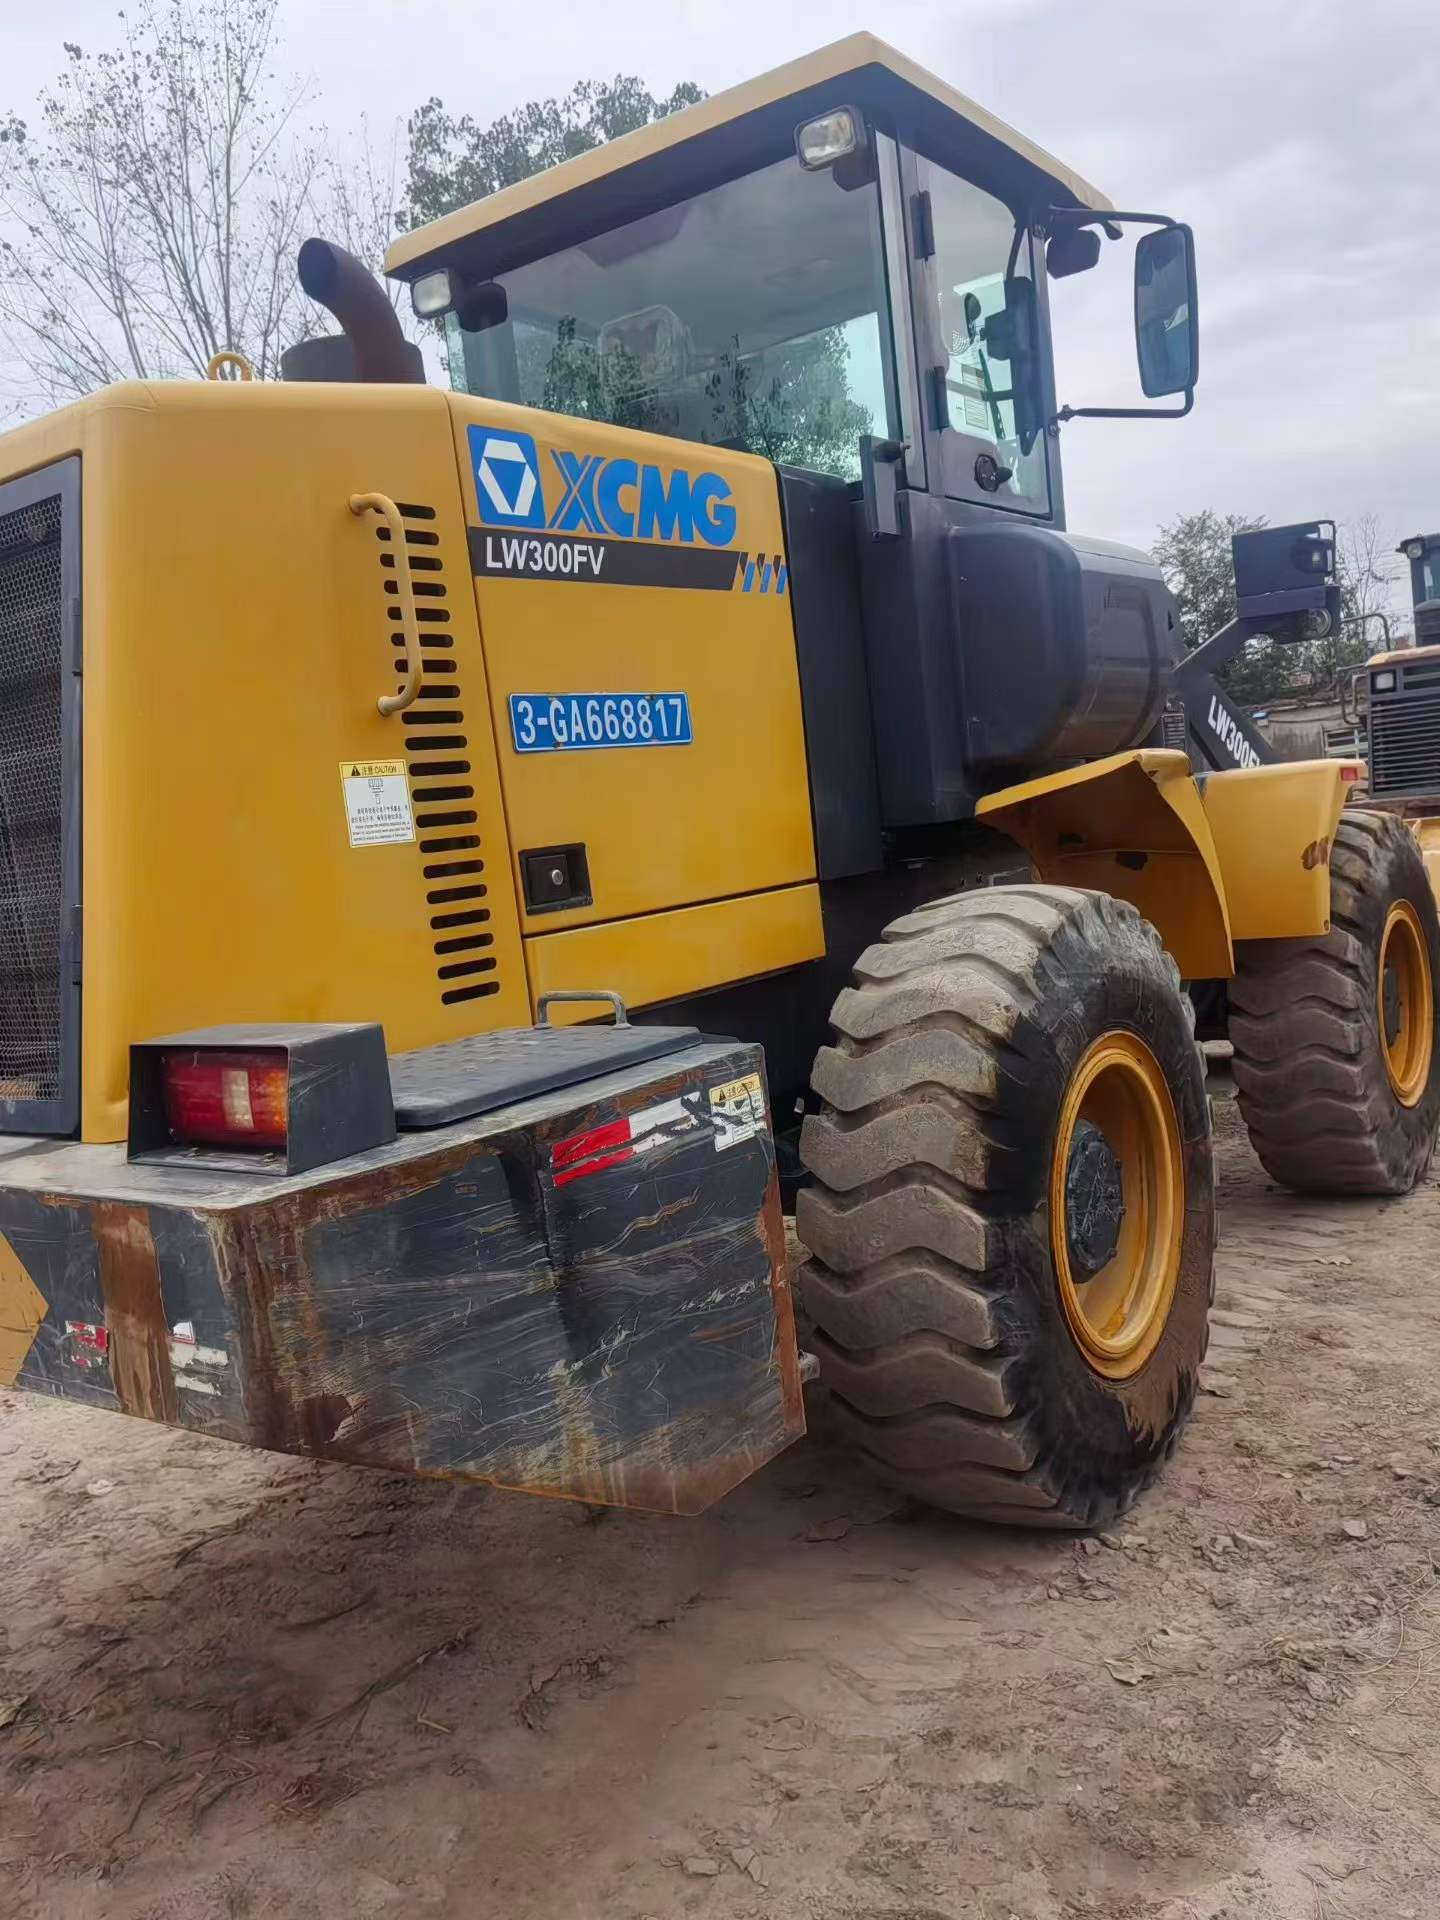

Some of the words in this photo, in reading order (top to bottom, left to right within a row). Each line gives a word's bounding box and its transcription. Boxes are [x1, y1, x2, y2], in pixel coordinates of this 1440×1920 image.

[550, 449, 736, 546] XCMG
[486, 537, 604, 575] LW300FV
[518, 699, 682, 744] 3-GA668817
[1208, 695, 1265, 769] LW300F
